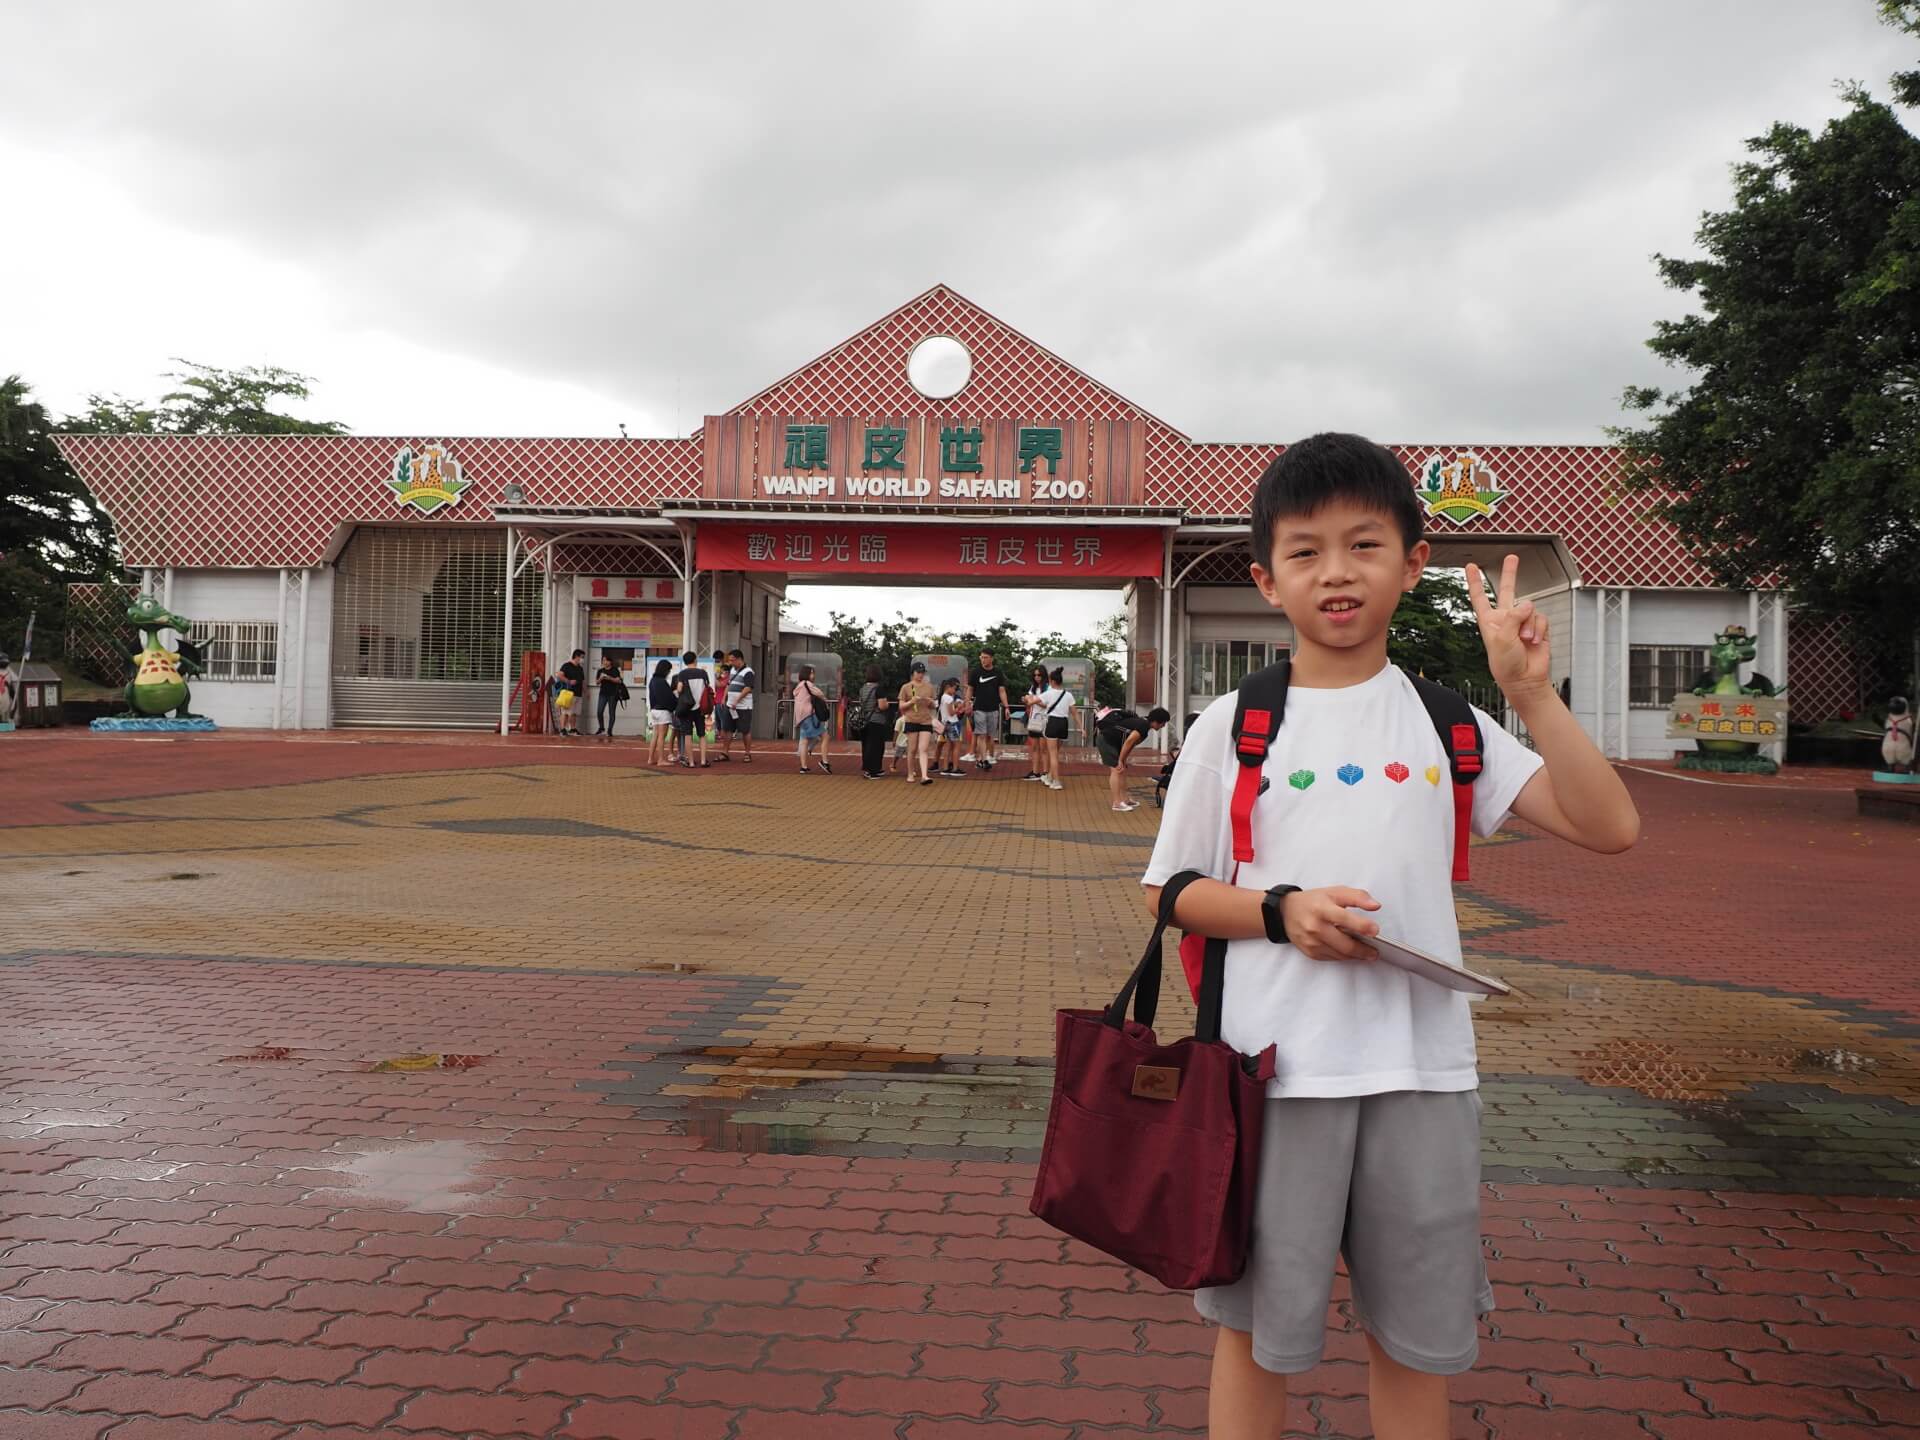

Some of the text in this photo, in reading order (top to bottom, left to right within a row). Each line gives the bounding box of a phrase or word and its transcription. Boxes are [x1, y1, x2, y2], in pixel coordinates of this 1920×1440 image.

[784, 424, 1063, 475] 頑皮世界
[762, 476, 1086, 500] WANPI WORLD SAFARI ZOO
[747, 533, 1102, 566] 歡迎光臨 頑皮世界
